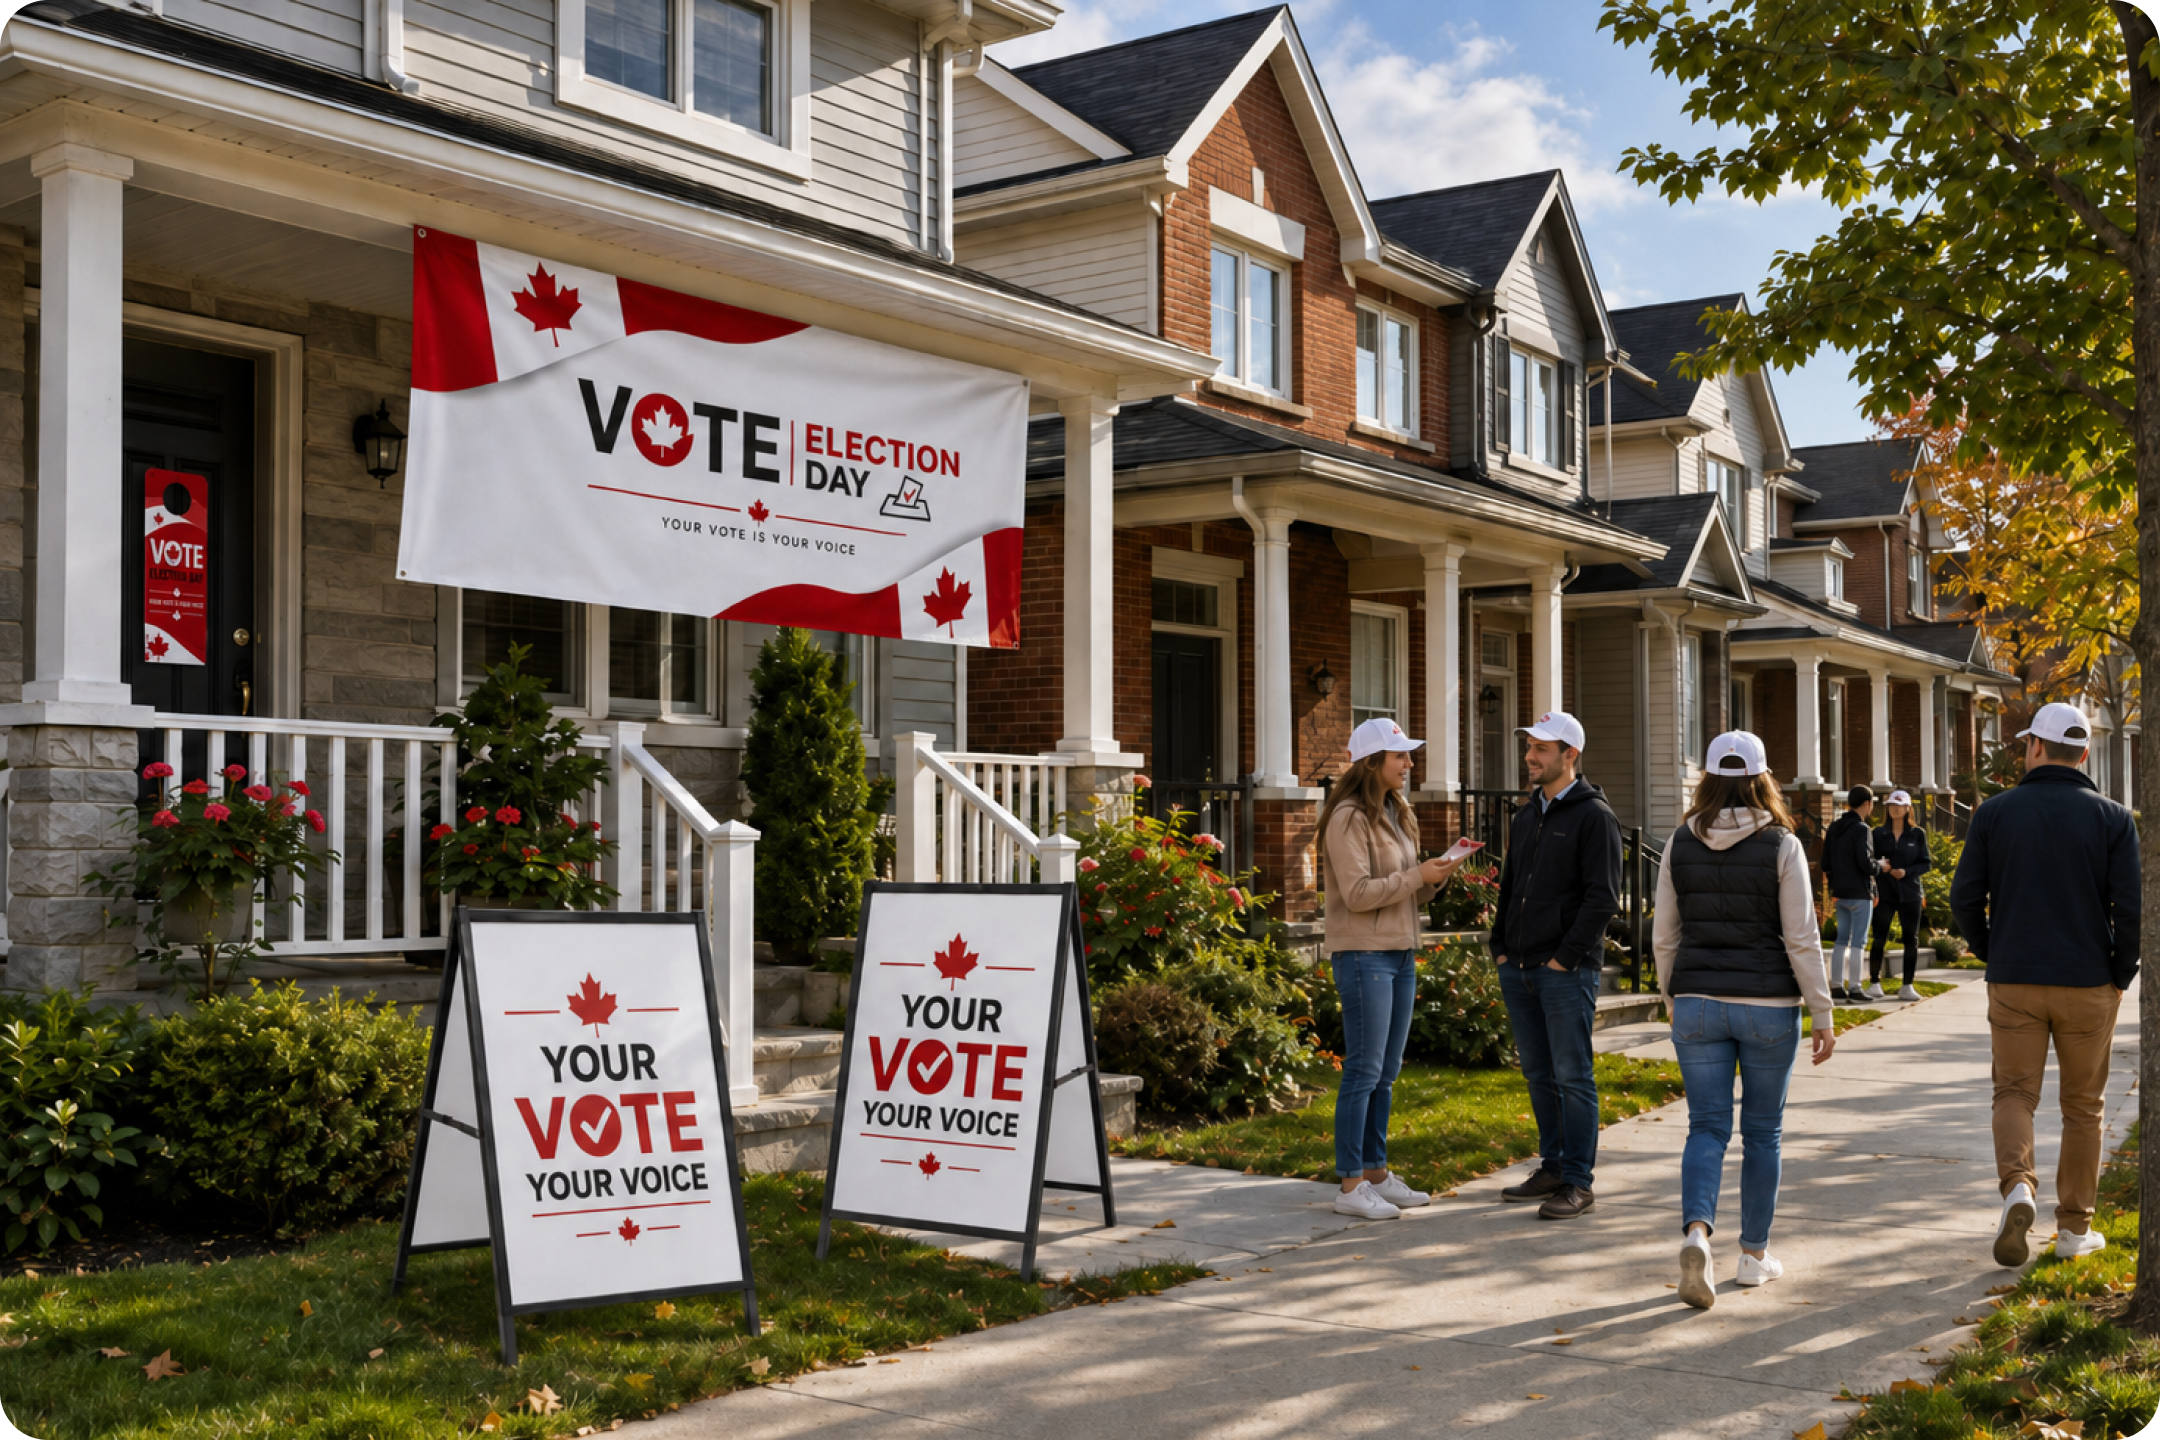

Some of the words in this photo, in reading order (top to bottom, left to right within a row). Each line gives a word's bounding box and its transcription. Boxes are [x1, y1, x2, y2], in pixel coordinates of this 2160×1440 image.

[577, 377, 781, 484] VOTE
[805, 422, 961, 478] ELECTION
[805, 459, 871, 498] DAY
[150, 537, 204, 569] VOTE
[661, 516, 702, 534] YOUR
[709, 524, 746, 541] VOTE
[752, 531, 766, 543] IS
[772, 533, 809, 549] YOUR
[815, 540, 856, 556] VOICE
[901, 993, 1003, 1034] YOUR
[540, 1043, 659, 1084] YOUR
[868, 1035, 1028, 1103] VOTE
[513, 1090, 705, 1160] VOTE
[863, 1100, 933, 1130] YOUR
[939, 1106, 1020, 1138] VOICE
[525, 1168, 615, 1203] YOUR
[619, 1162, 709, 1196] VOICE
